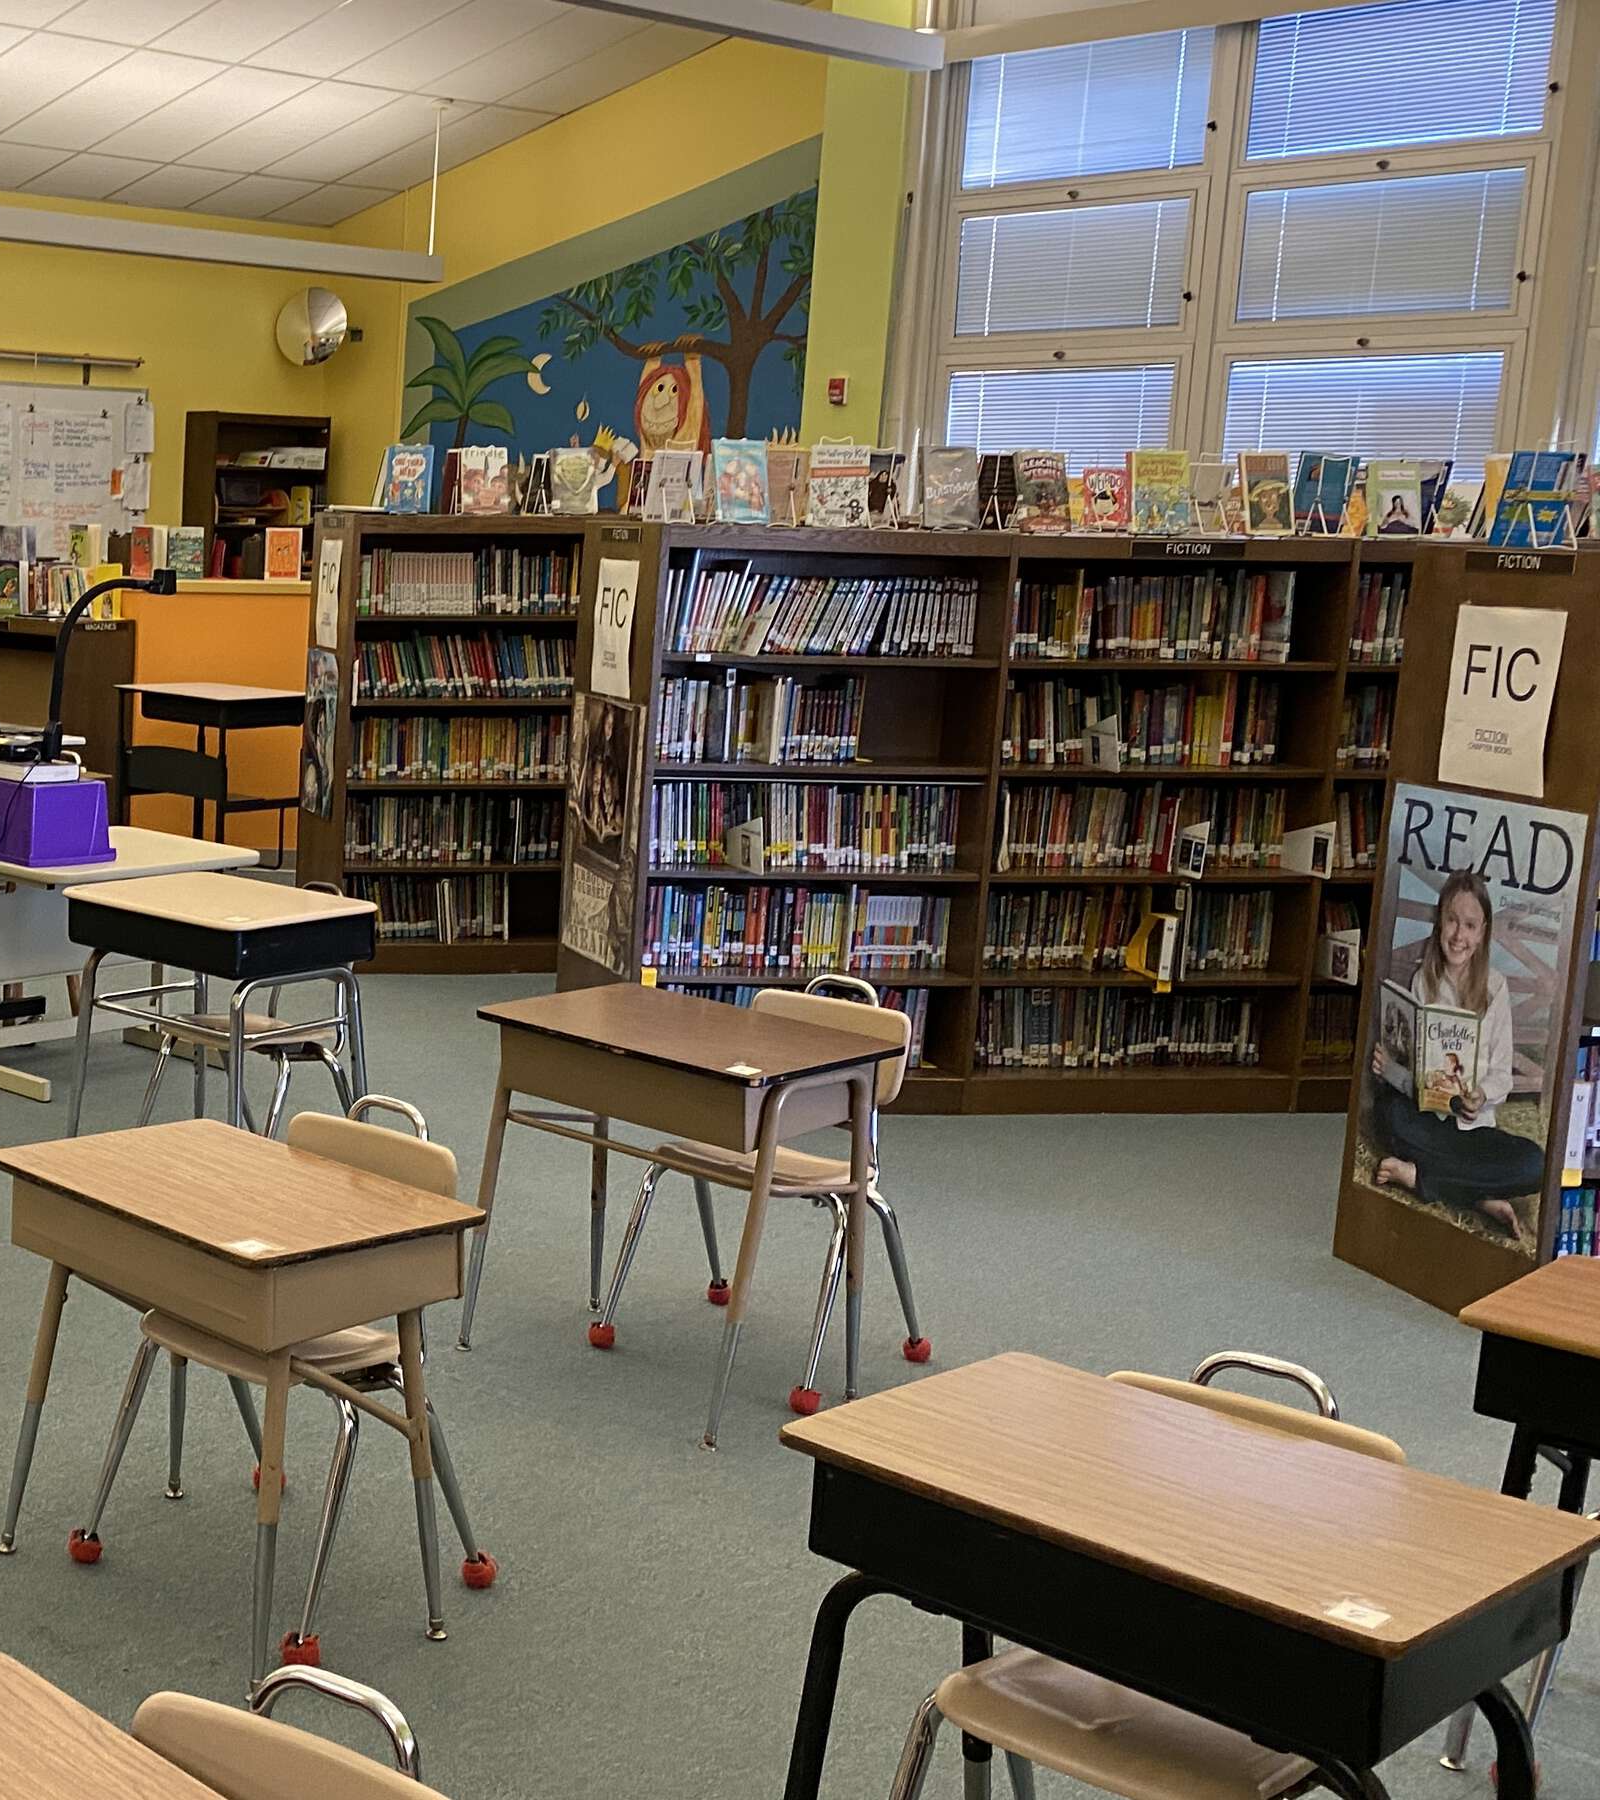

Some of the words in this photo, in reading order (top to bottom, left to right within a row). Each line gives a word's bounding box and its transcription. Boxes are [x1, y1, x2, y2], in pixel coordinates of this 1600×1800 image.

[1166, 543, 1211, 555] FICTION
[1497, 554, 1541, 570] FICTION
[321, 562, 336, 594] FIC
[600, 586, 629, 629] FIC
[1463, 644, 1541, 702] FIC
[1475, 728, 1508, 745] FICTION
[1397, 798, 1574, 895] READ
